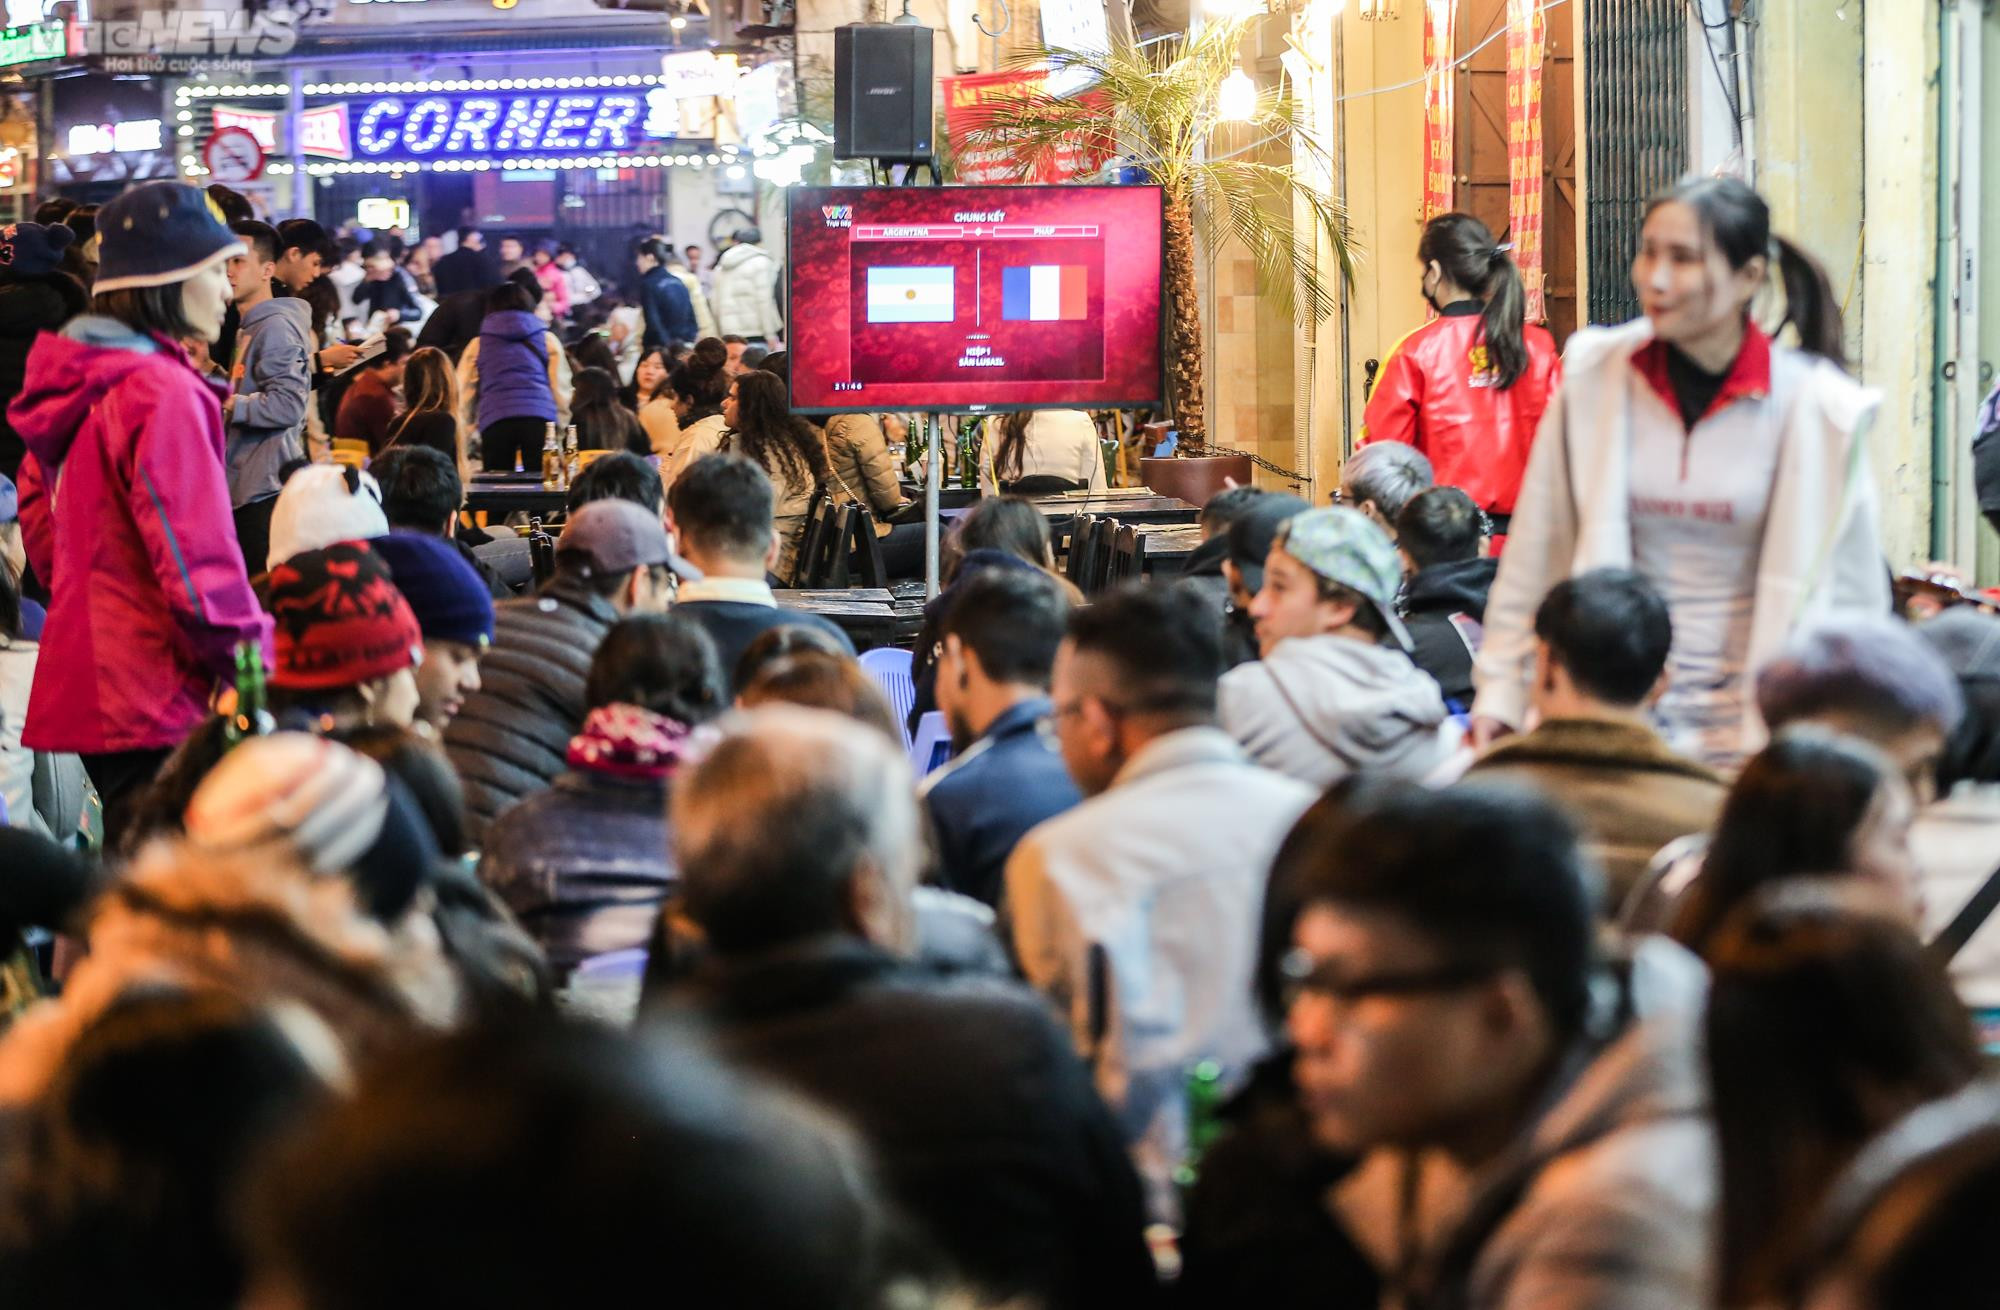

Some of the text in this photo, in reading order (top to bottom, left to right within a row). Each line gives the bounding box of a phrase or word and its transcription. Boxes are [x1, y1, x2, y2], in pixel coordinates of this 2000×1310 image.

[357, 96, 640, 155] CORNER
[822, 206, 853, 219] VTV2
[954, 211, 1005, 223] CHUNG KẾT
[883, 229, 928, 237] ARGENTINA
[834, 382, 863, 391] 21:46
